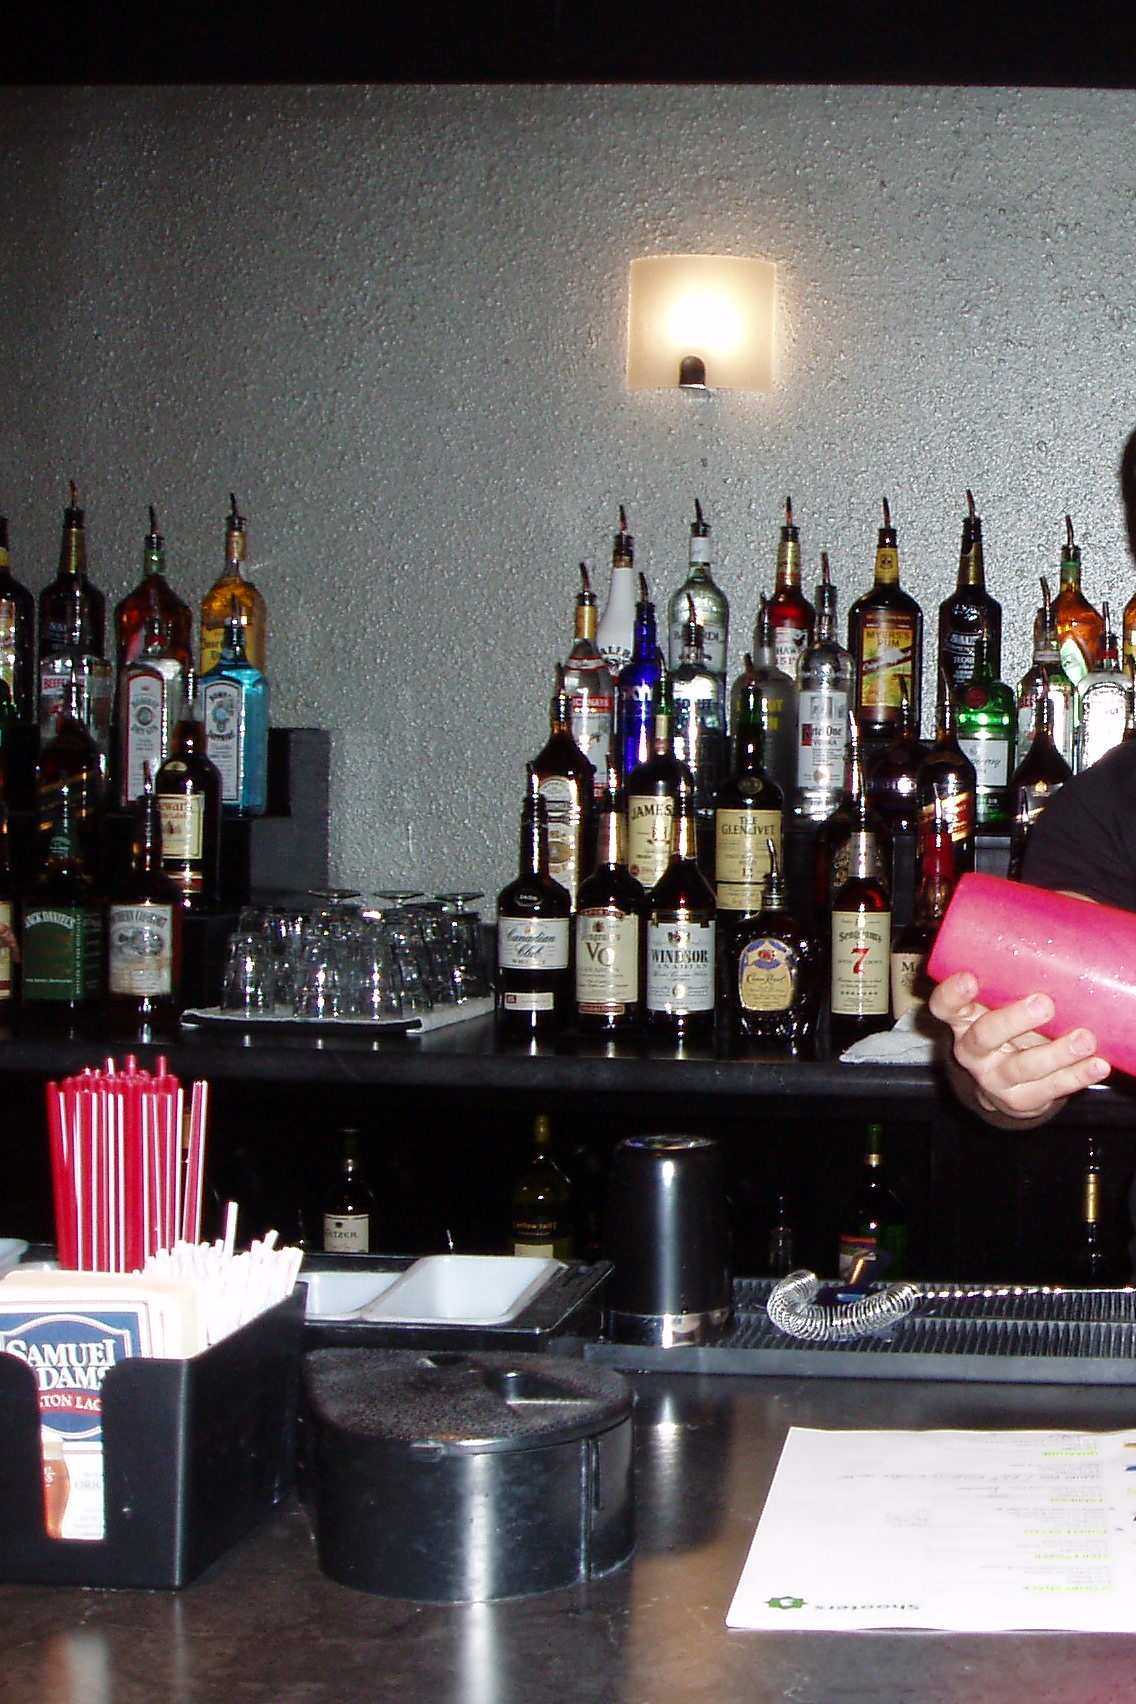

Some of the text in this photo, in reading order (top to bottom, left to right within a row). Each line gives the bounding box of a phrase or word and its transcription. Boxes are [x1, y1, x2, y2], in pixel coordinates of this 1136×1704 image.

[631, 803, 674, 821] JAMES
[721, 824, 775, 836] GLENLIVET
[506, 928, 557, 946] Canadian
[838, 931, 883, 945] Seagram's
[517, 946, 544, 959] Club
[652, 948, 709, 964] WINDSOR
[850, 947, 870, 975] 7
[40, 1394, 72, 1408] STON
[814, 1601, 921, 1611] Shooters
